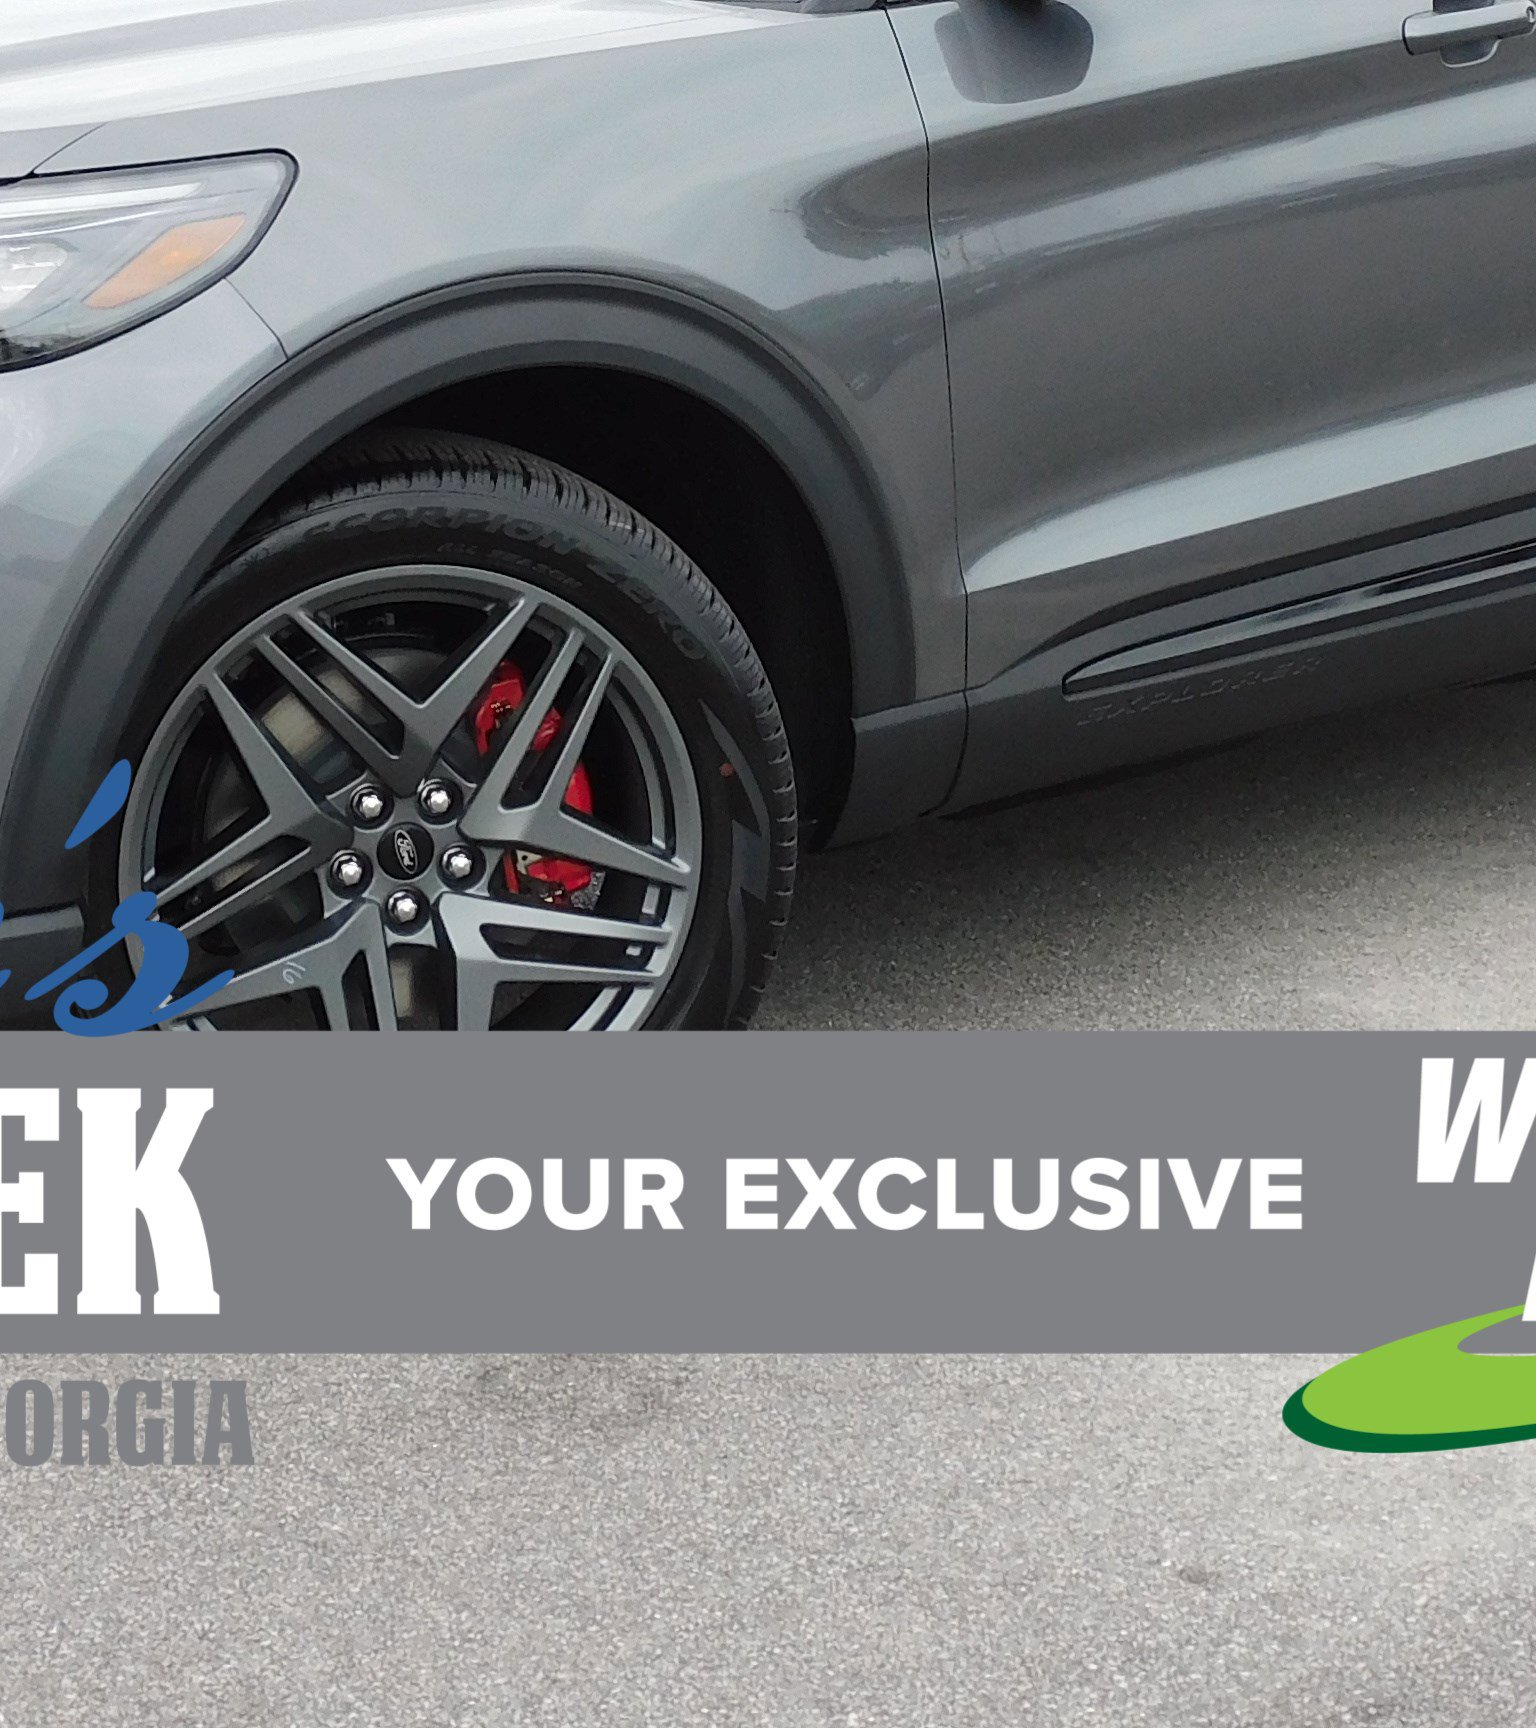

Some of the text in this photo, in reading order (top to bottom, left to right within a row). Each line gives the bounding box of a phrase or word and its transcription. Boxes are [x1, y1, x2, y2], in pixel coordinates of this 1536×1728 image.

[304, 506, 708, 660] SCORPION ZERO
[1075, 656, 1325, 727] EXPLORER
